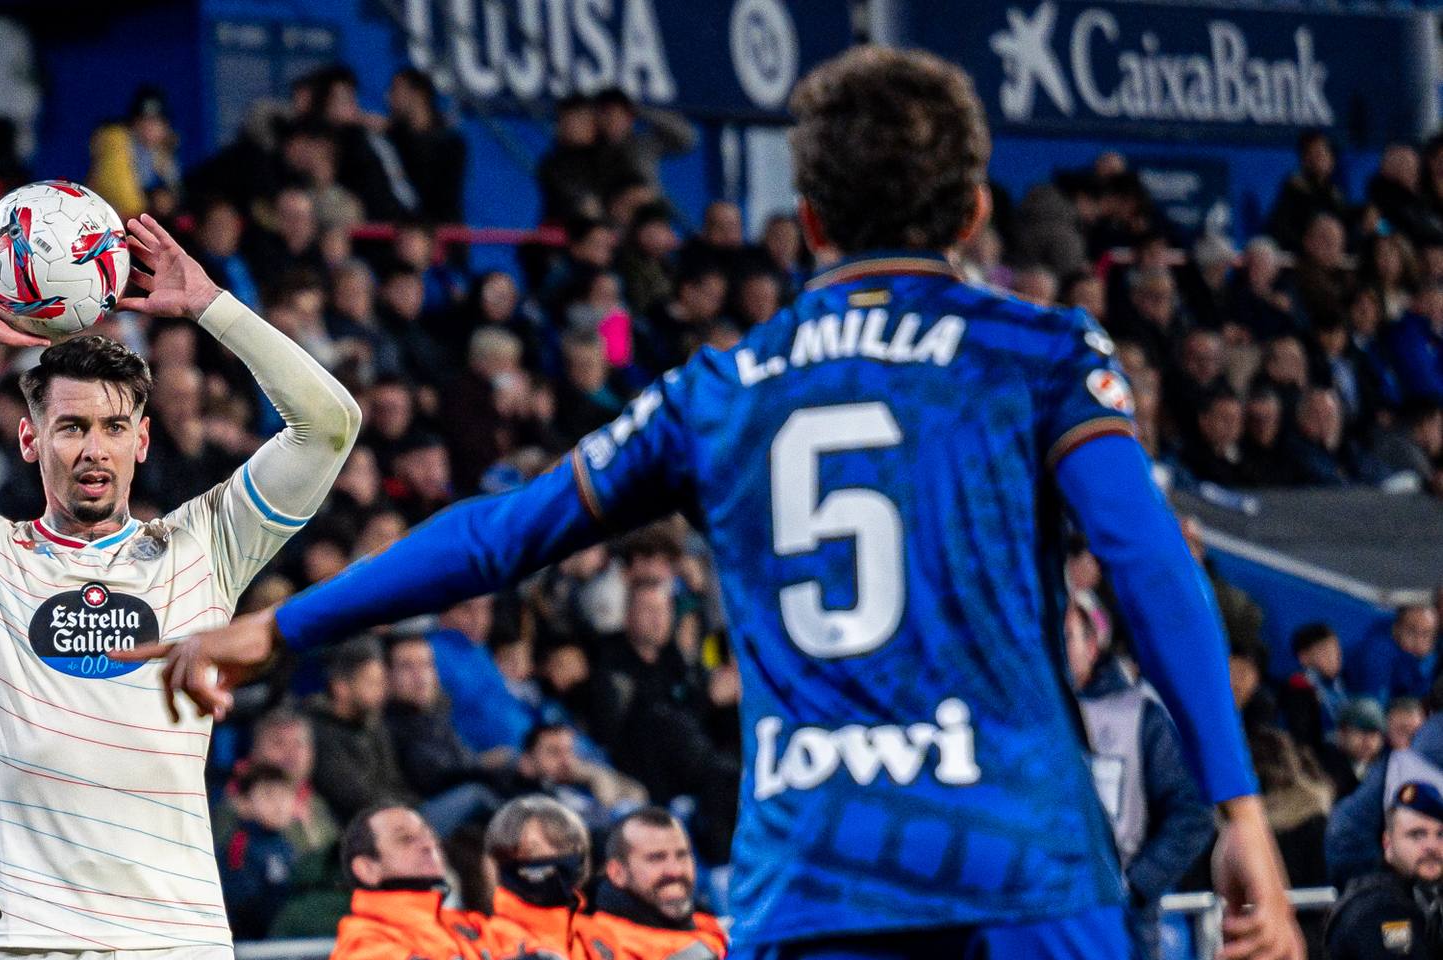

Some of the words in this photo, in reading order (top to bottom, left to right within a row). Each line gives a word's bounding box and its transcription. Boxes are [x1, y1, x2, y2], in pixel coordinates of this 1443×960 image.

[1069, 8, 1335, 127] CaixaBank
[735, 348, 787, 388] L.
[790, 308, 966, 367] MILLA
[771, 402, 905, 659] 5
[50, 604, 140, 629] Estrella
[53, 629, 135, 653] Galicia
[754, 697, 981, 800] Lowi
